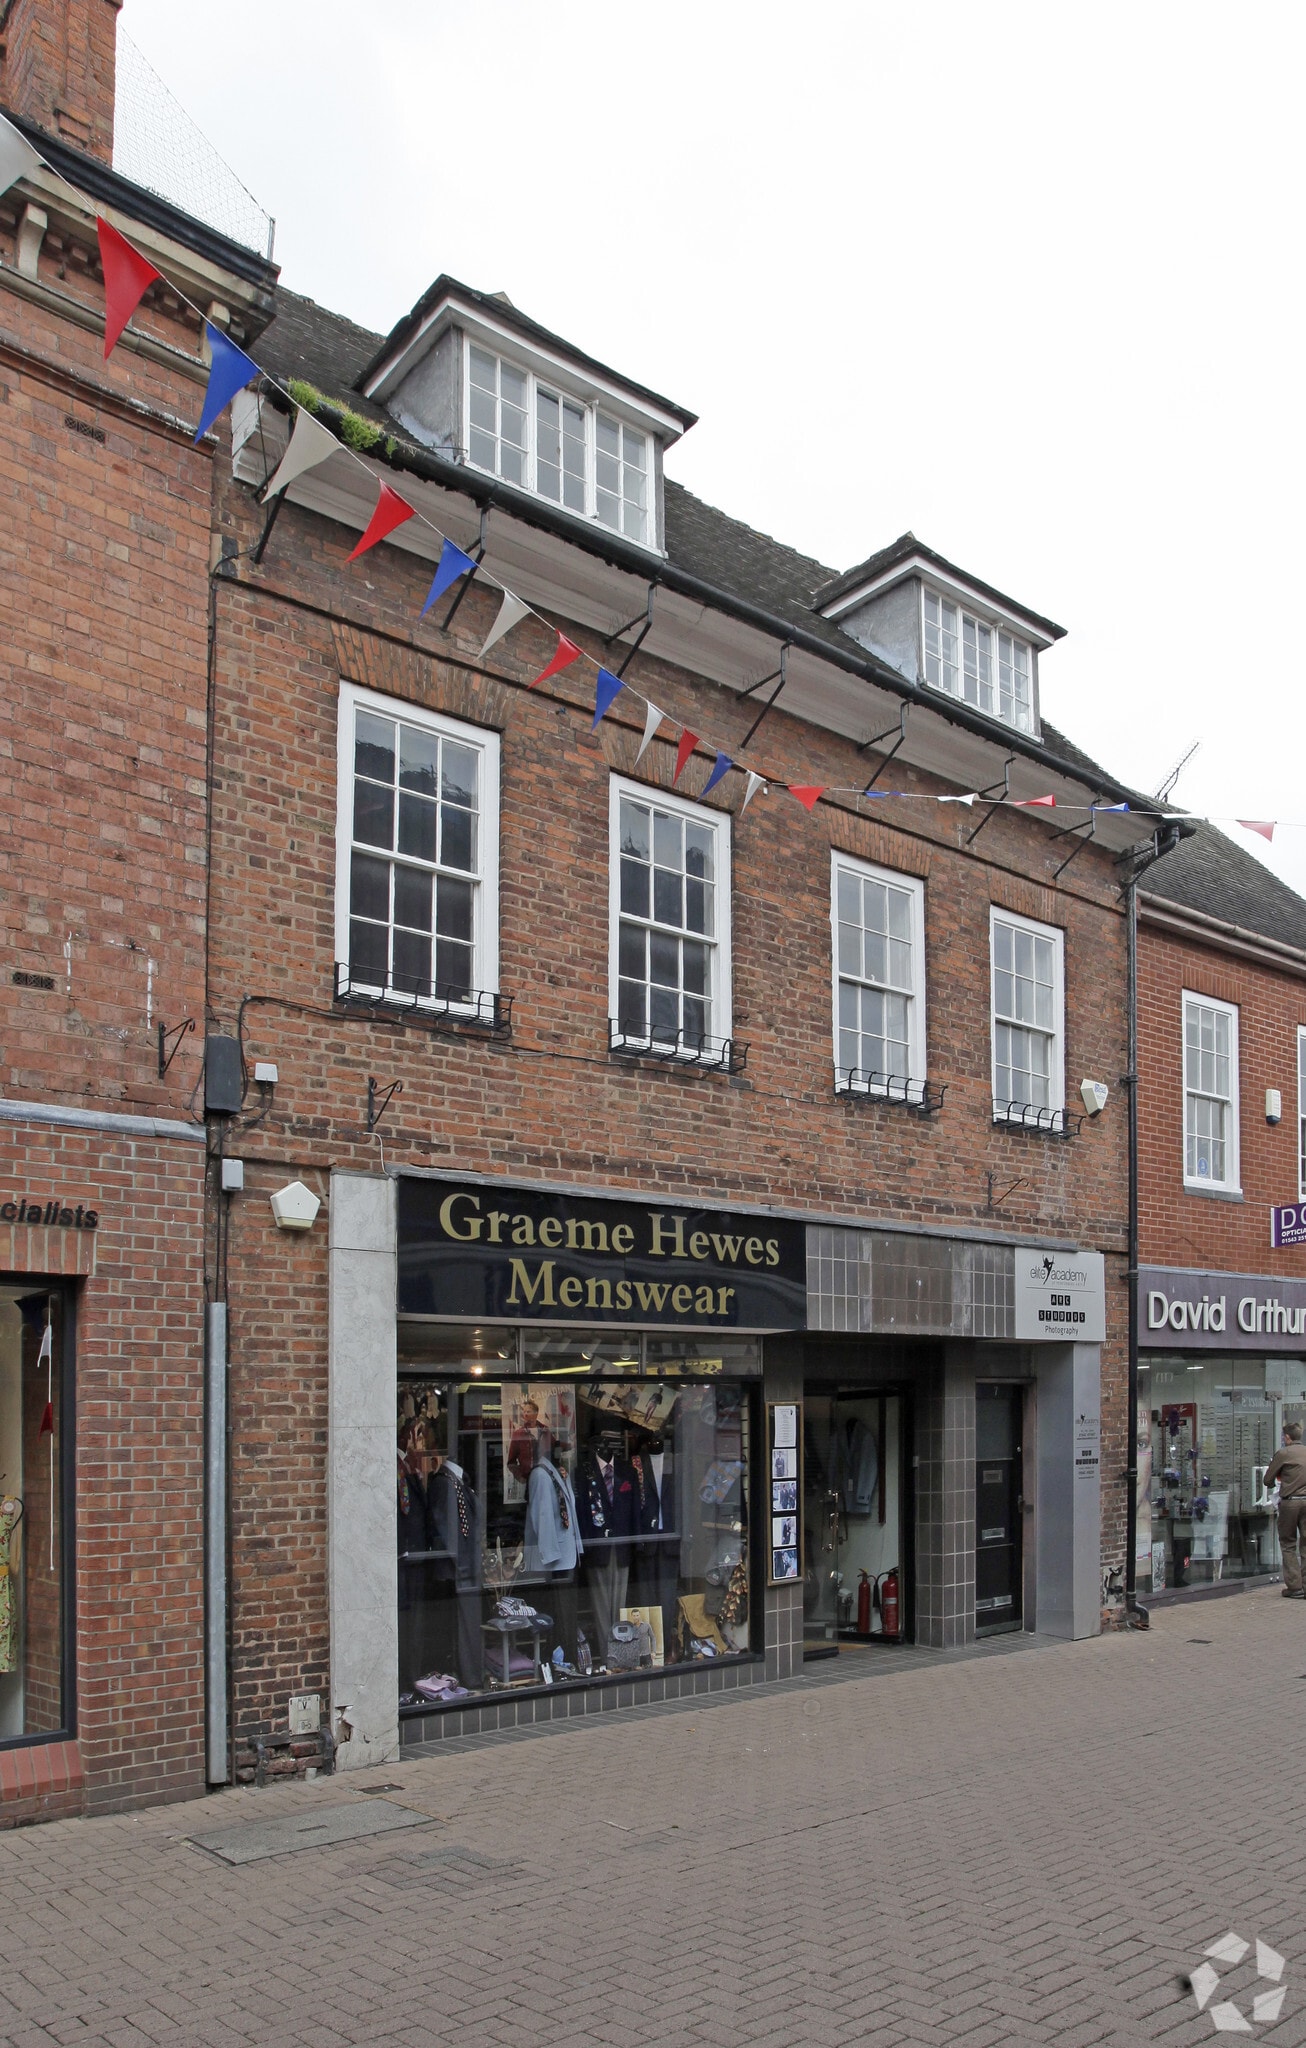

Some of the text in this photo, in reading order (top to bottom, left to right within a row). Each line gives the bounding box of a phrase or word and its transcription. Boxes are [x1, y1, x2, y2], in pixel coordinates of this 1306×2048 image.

[0, 1199, 98, 1228] cialists
[439, 1192, 779, 1266] Graeme Hewes
[506, 1258, 735, 1316] Menswear
[1030, 1265, 1087, 1286] elite academy
[1038, 1310, 1086, 1323] STUDIOS
[1148, 1291, 1226, 1331] David
[1045, 1325, 1078, 1336] Photography
